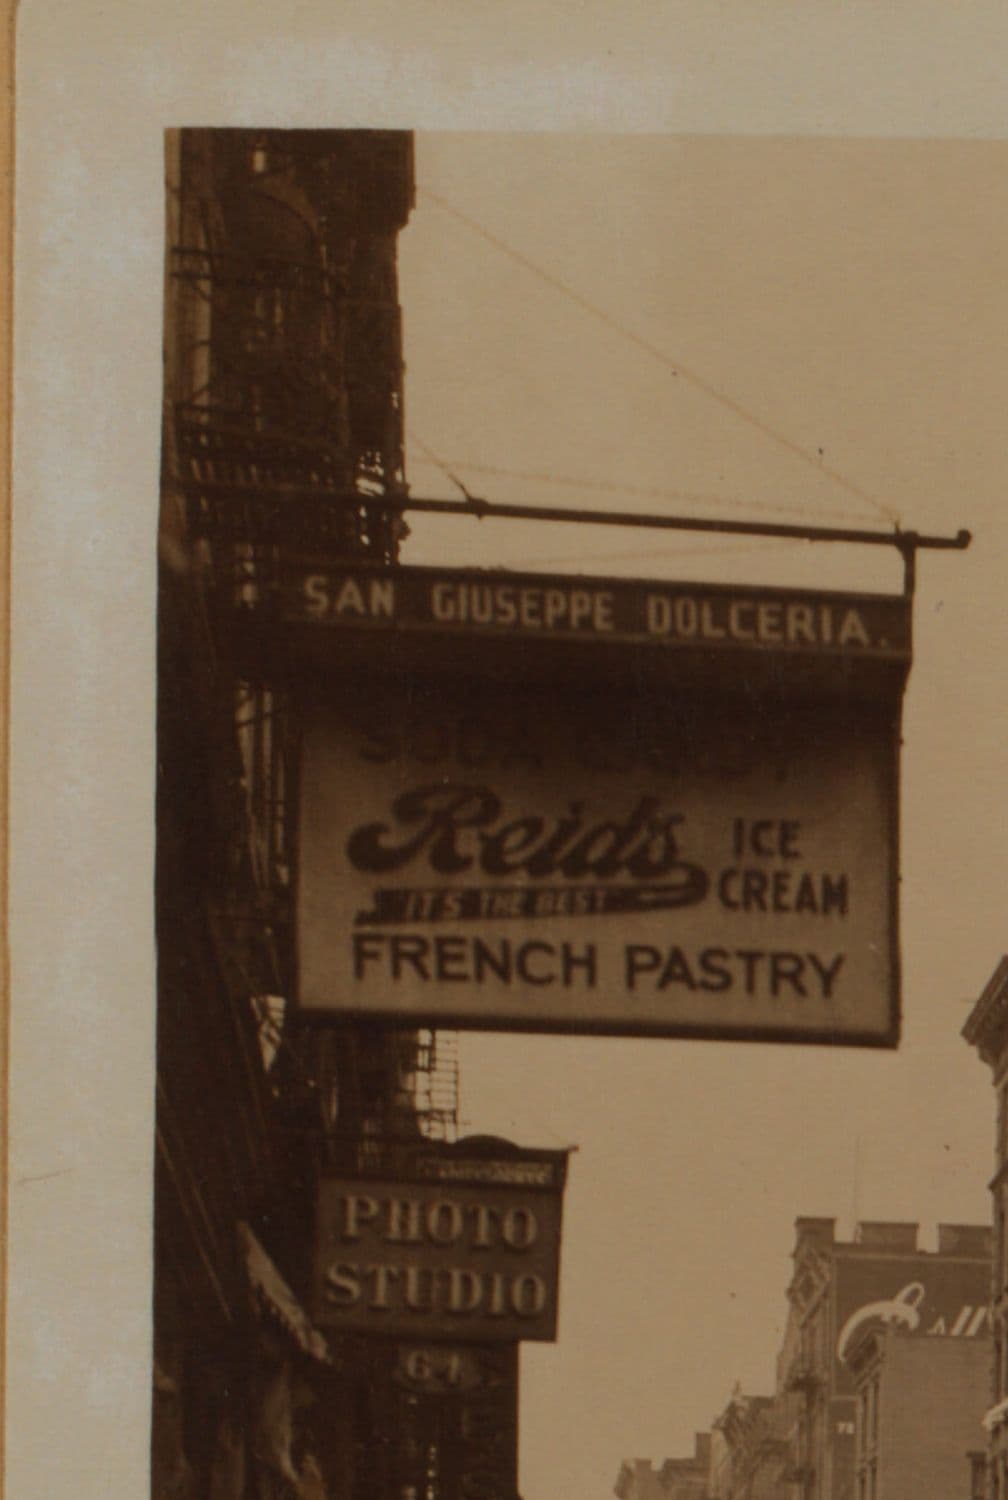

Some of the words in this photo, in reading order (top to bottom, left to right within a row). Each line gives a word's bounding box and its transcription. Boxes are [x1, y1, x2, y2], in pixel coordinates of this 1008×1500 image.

[304, 575, 396, 617] SAN
[432, 584, 615, 631] GIUSEPPE
[732, 818, 802, 858] ICE
[719, 867, 848, 914] CREAM
[353, 933, 596, 988] FRENCH
[625, 944, 846, 998] PASTRY
[340, 1195, 539, 1252] PHOTO
[325, 1263, 547, 1318] STUDIO
